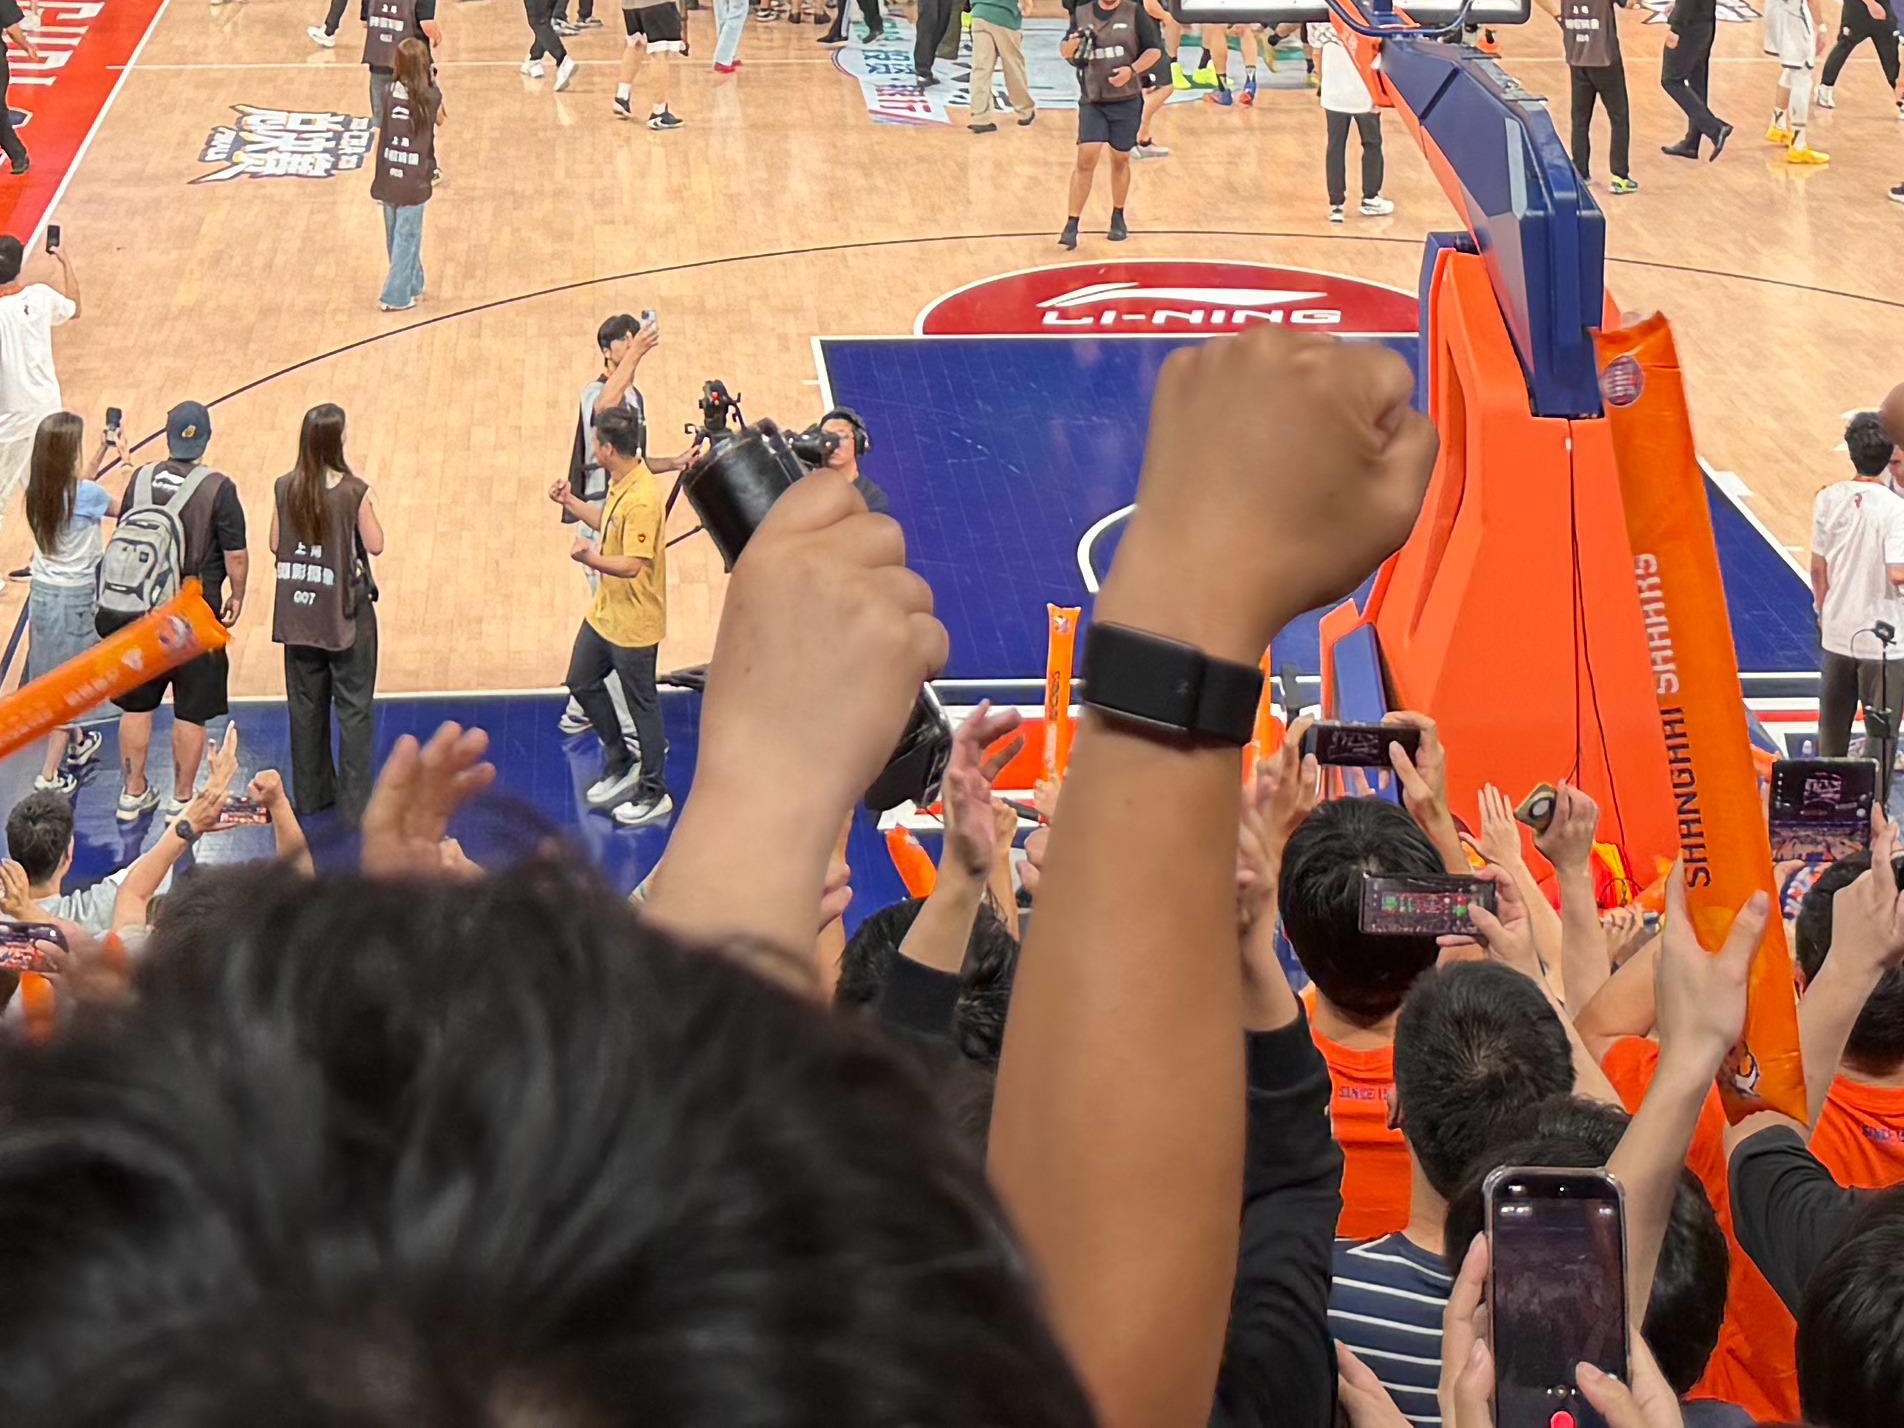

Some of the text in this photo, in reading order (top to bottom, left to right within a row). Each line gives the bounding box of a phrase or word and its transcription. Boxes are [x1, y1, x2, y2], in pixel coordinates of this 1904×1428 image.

[1042, 308, 1343, 326] LI-NING
[1632, 552, 1713, 890] SHANGHAI SHARKS
